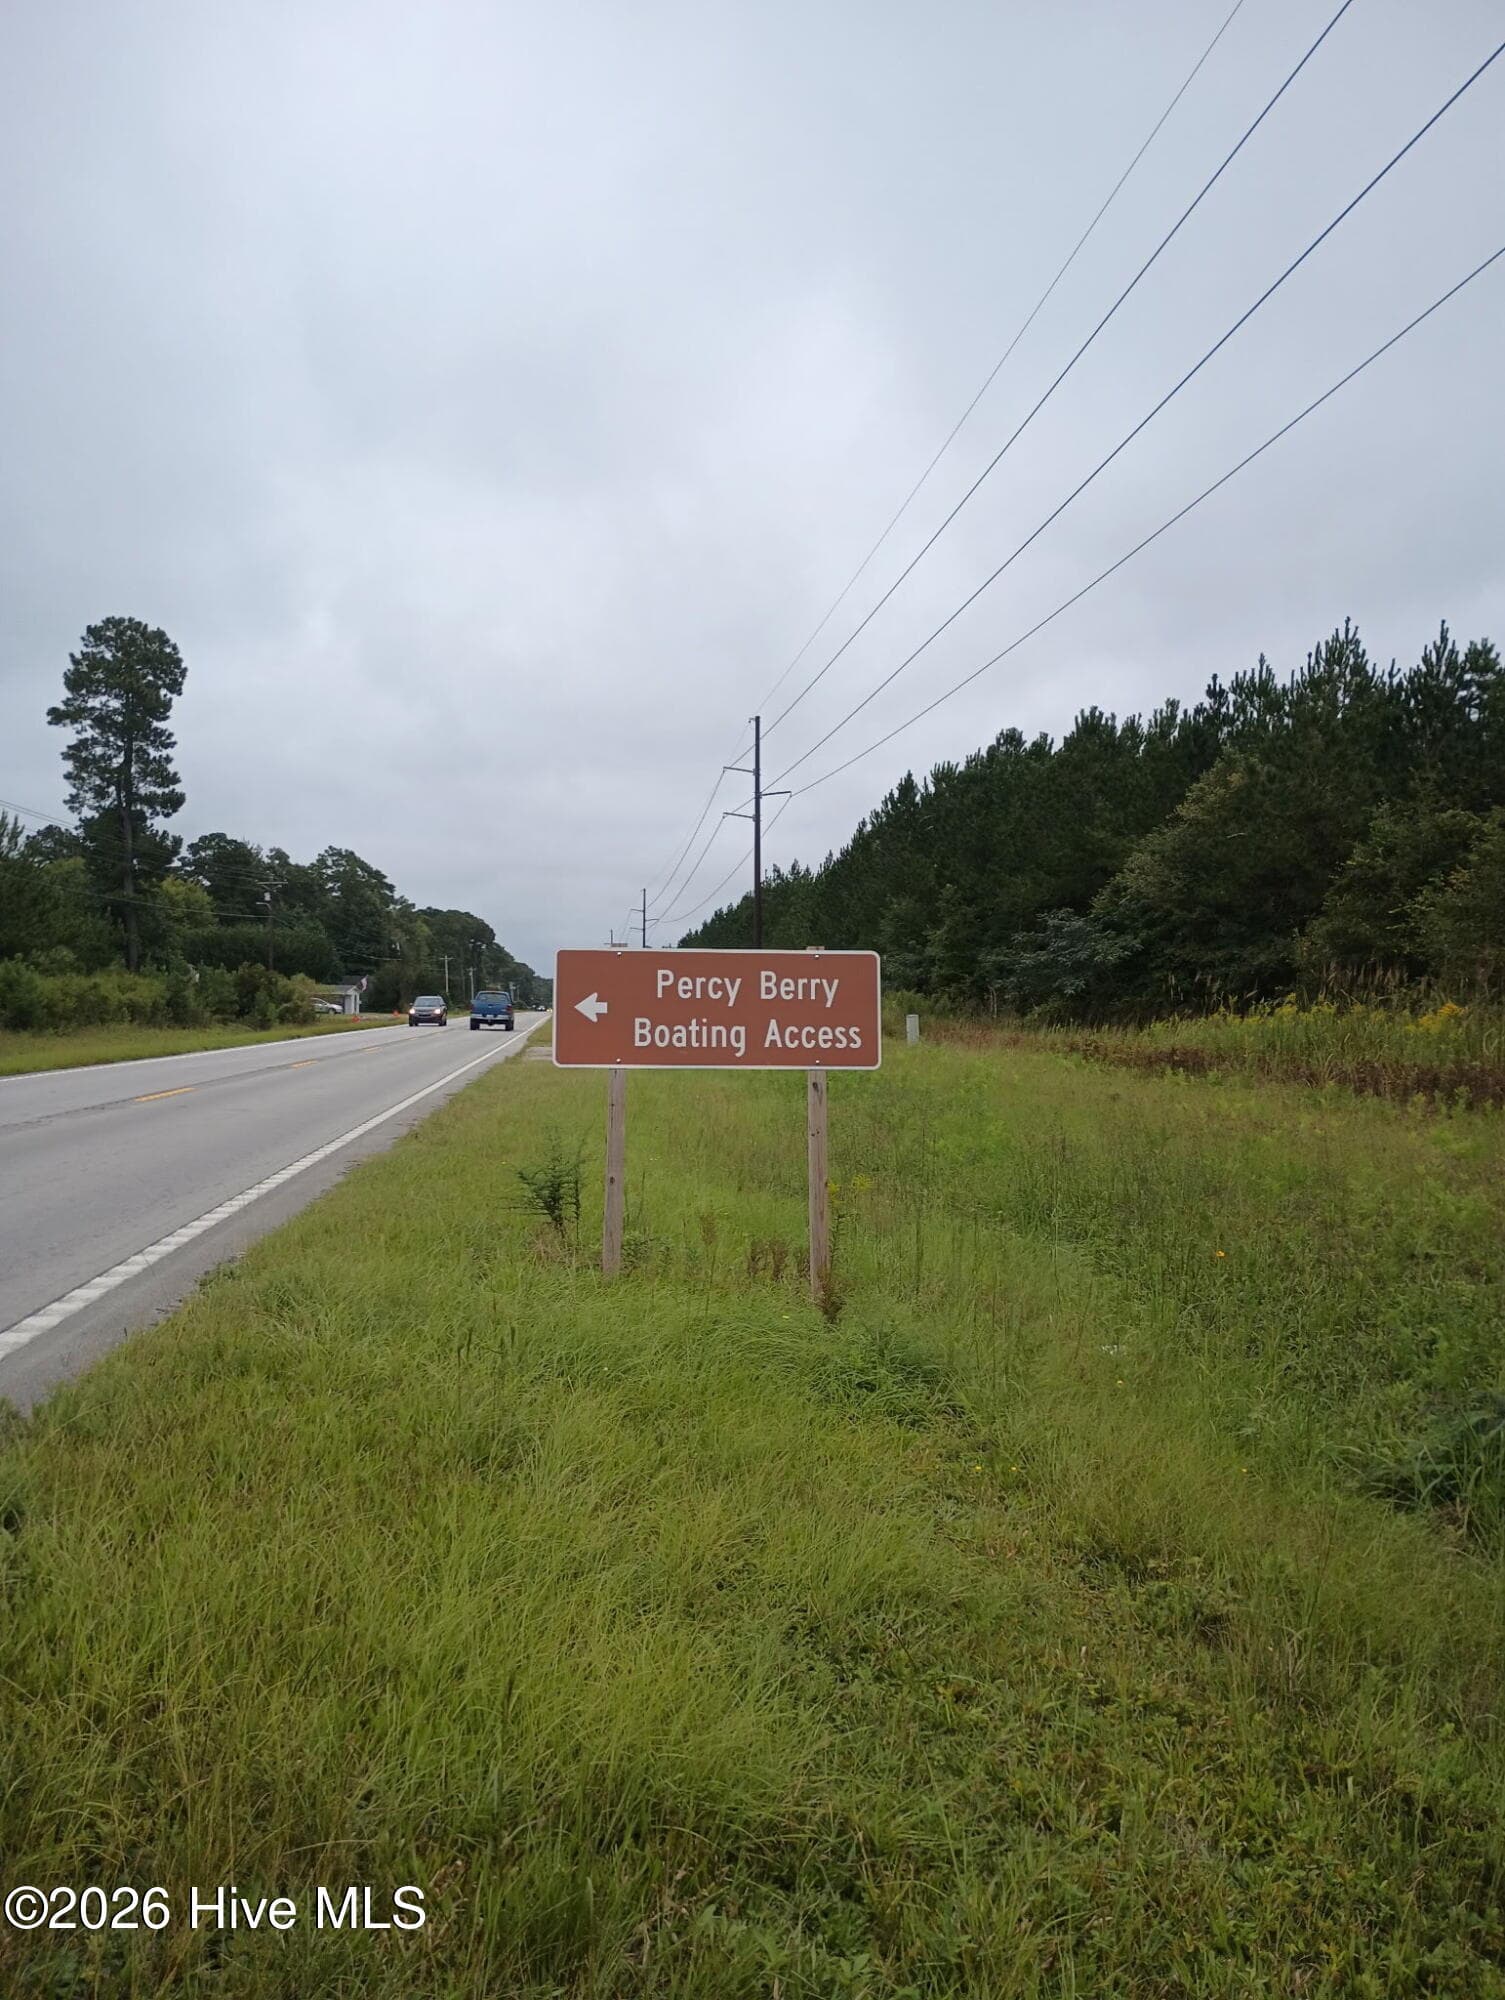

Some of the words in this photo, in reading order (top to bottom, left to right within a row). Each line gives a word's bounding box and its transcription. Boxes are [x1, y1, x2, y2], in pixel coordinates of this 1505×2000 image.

[656, 969, 742, 1007] Percy
[760, 971, 839, 1007] Berry
[634, 1017, 746, 1057] Boating
[764, 1019, 862, 1049] Access
